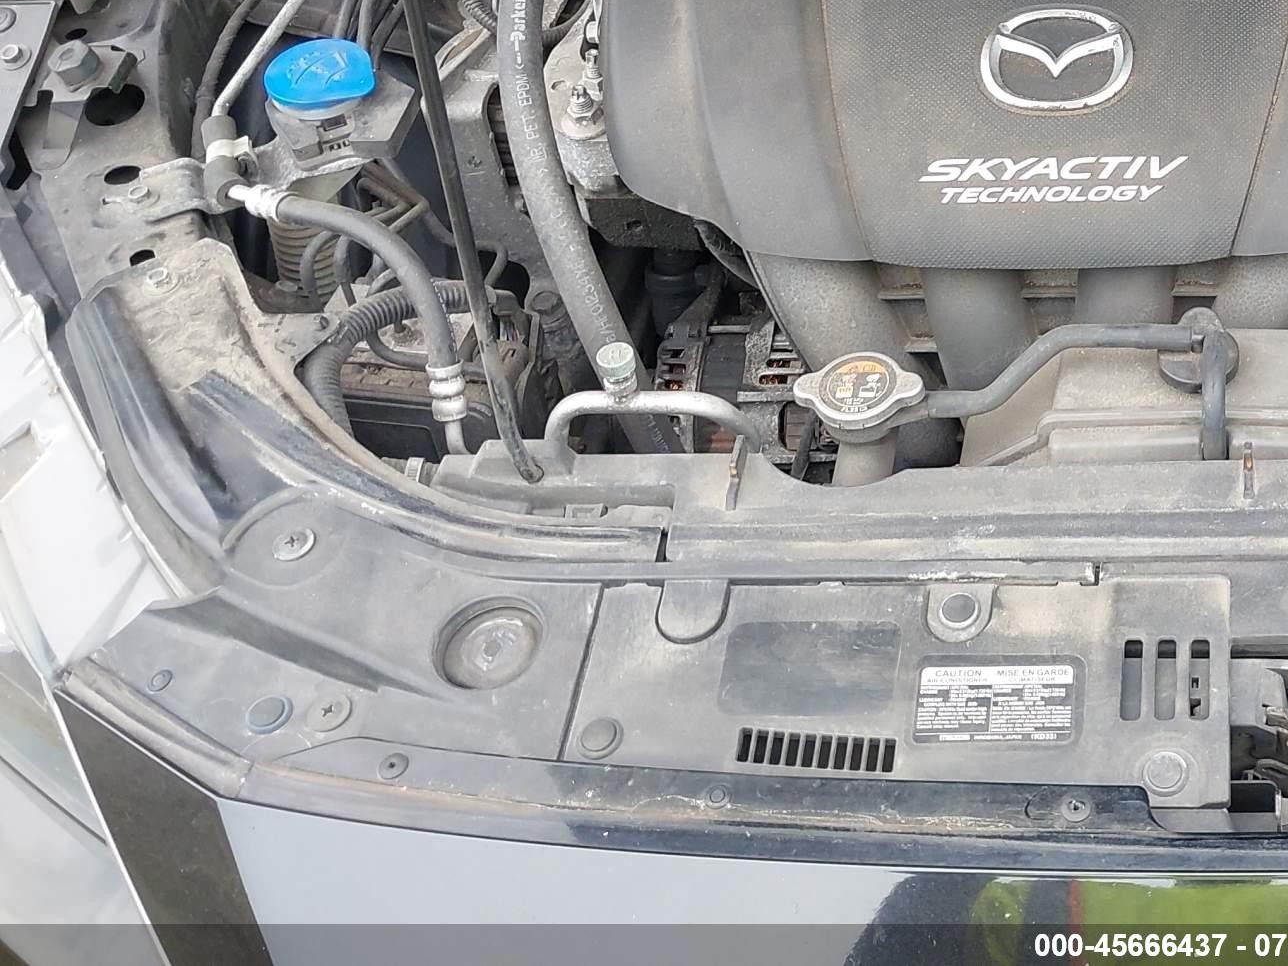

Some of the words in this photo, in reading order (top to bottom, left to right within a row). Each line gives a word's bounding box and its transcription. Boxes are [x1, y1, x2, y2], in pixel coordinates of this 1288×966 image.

[515, 73, 533, 107] EPDM
[918, 155, 1189, 182] SKYACTIV
[940, 184, 1165, 204] TECHNOLOGY
[935, 669, 982, 677] CAUTION
[1036, 668, 1069, 676] GARDE
